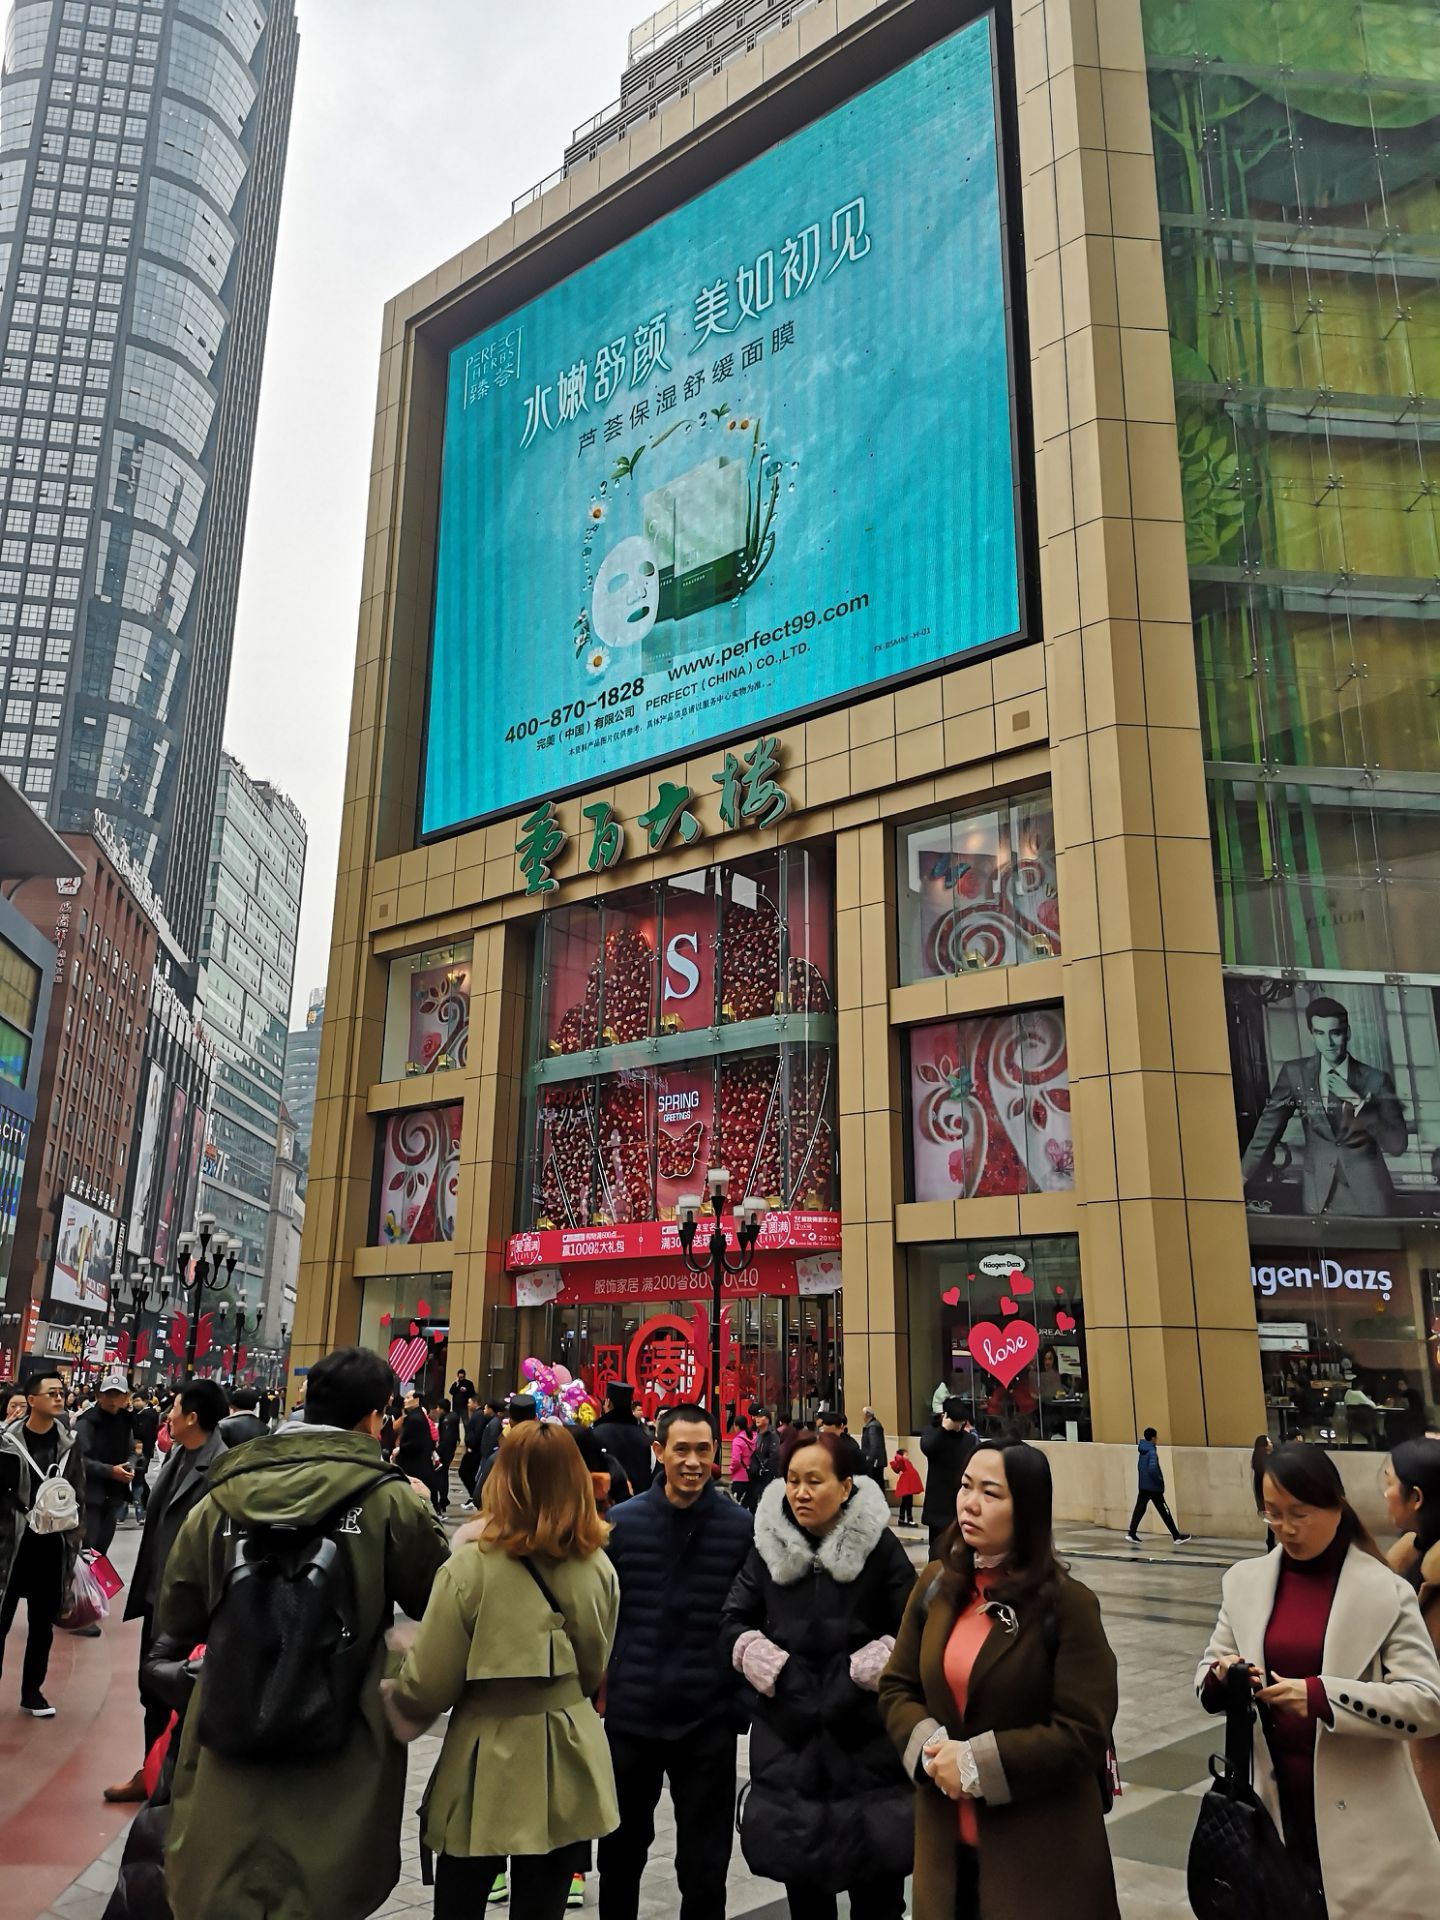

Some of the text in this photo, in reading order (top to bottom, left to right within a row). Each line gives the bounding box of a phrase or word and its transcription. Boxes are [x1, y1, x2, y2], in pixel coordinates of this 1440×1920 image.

[519, 196, 871, 449] 水嫩舒颜 美如初见
[464, 326, 524, 370] PERFECT
[578, 320, 795, 459] 芦荟保湿舒缓面膜
[504, 593, 869, 743] 400-870-1828 www.perfect99.com
[645, 684, 698, 711] PERFECT
[664, 931, 701, 1001] S
[658, 1090, 699, 1112] SPRING
[663, 1110, 691, 1122] GREETINGS
[594, 1277, 639, 1295] 服饰家居
[983, 1336, 1028, 1366] love
